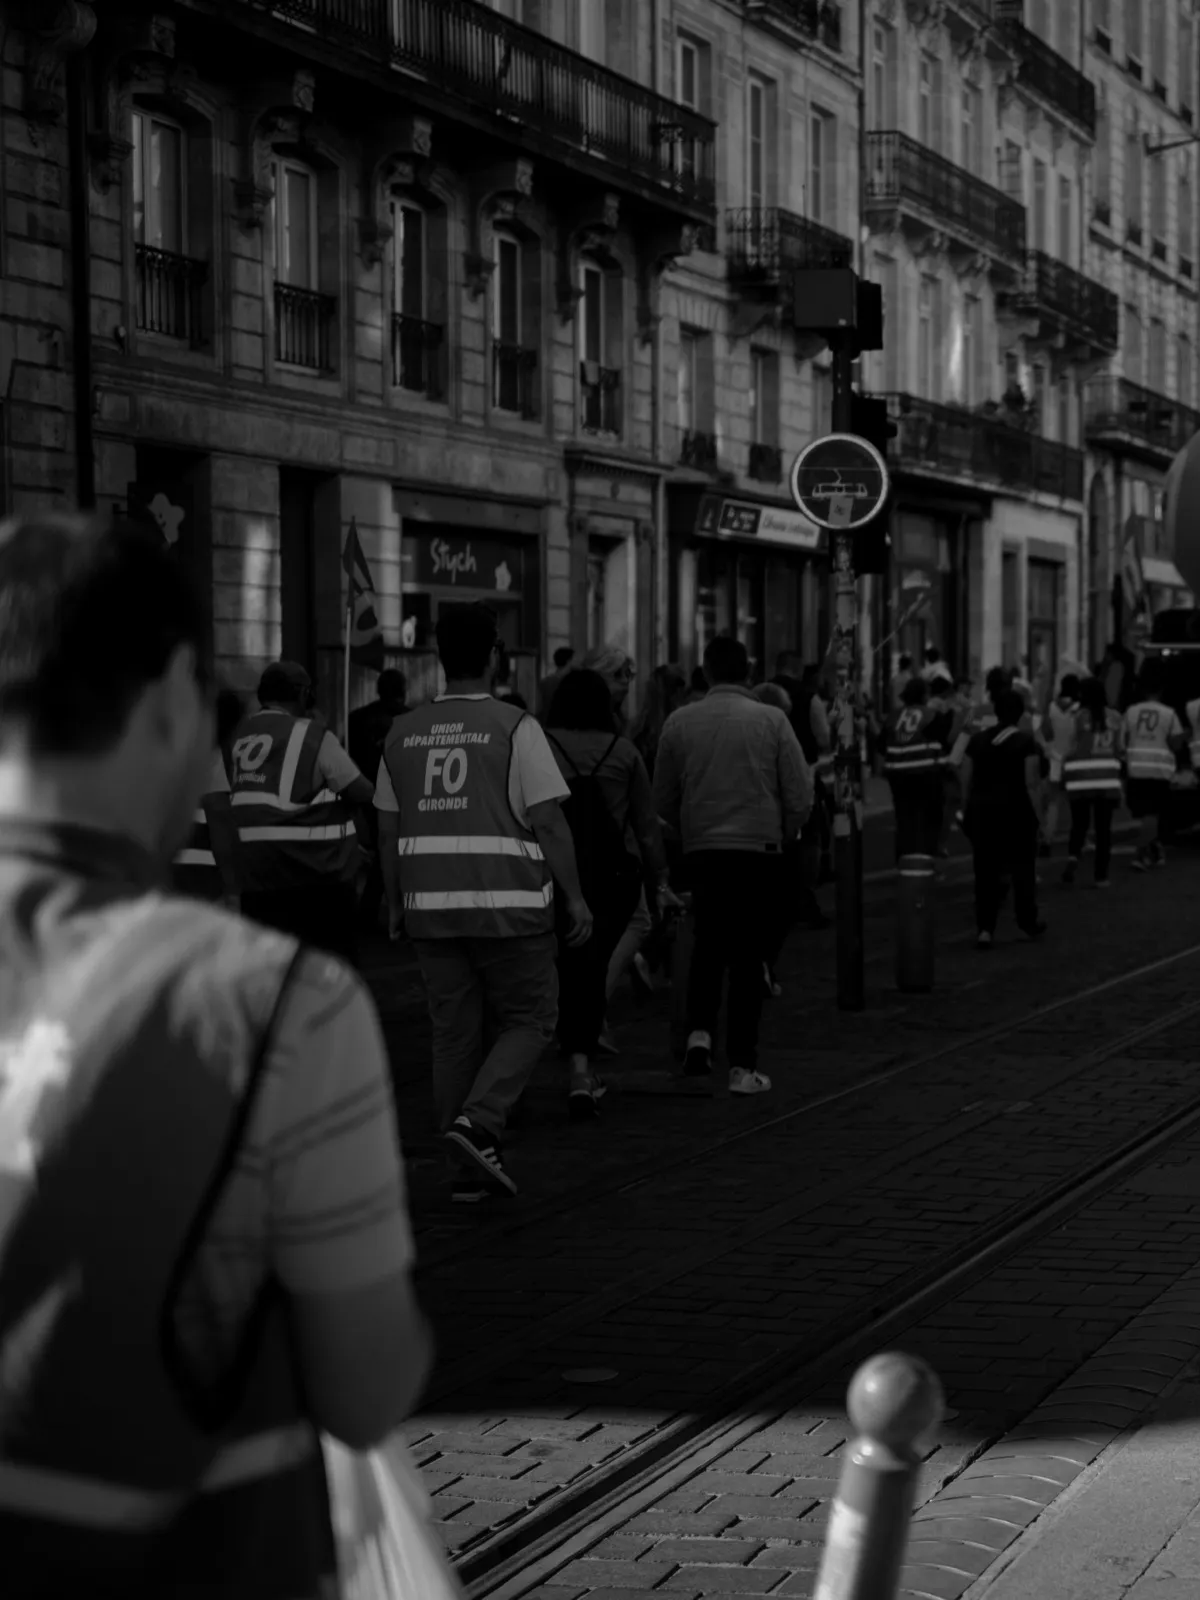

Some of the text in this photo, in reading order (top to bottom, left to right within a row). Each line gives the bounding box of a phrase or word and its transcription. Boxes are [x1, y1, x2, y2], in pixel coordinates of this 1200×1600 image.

[430, 537, 477, 584] Stych
[430, 722, 464, 734] UNION
[1137, 708, 1159, 731] FO
[424, 747, 468, 796] FO
[417, 796, 468, 812] GIRONDE
